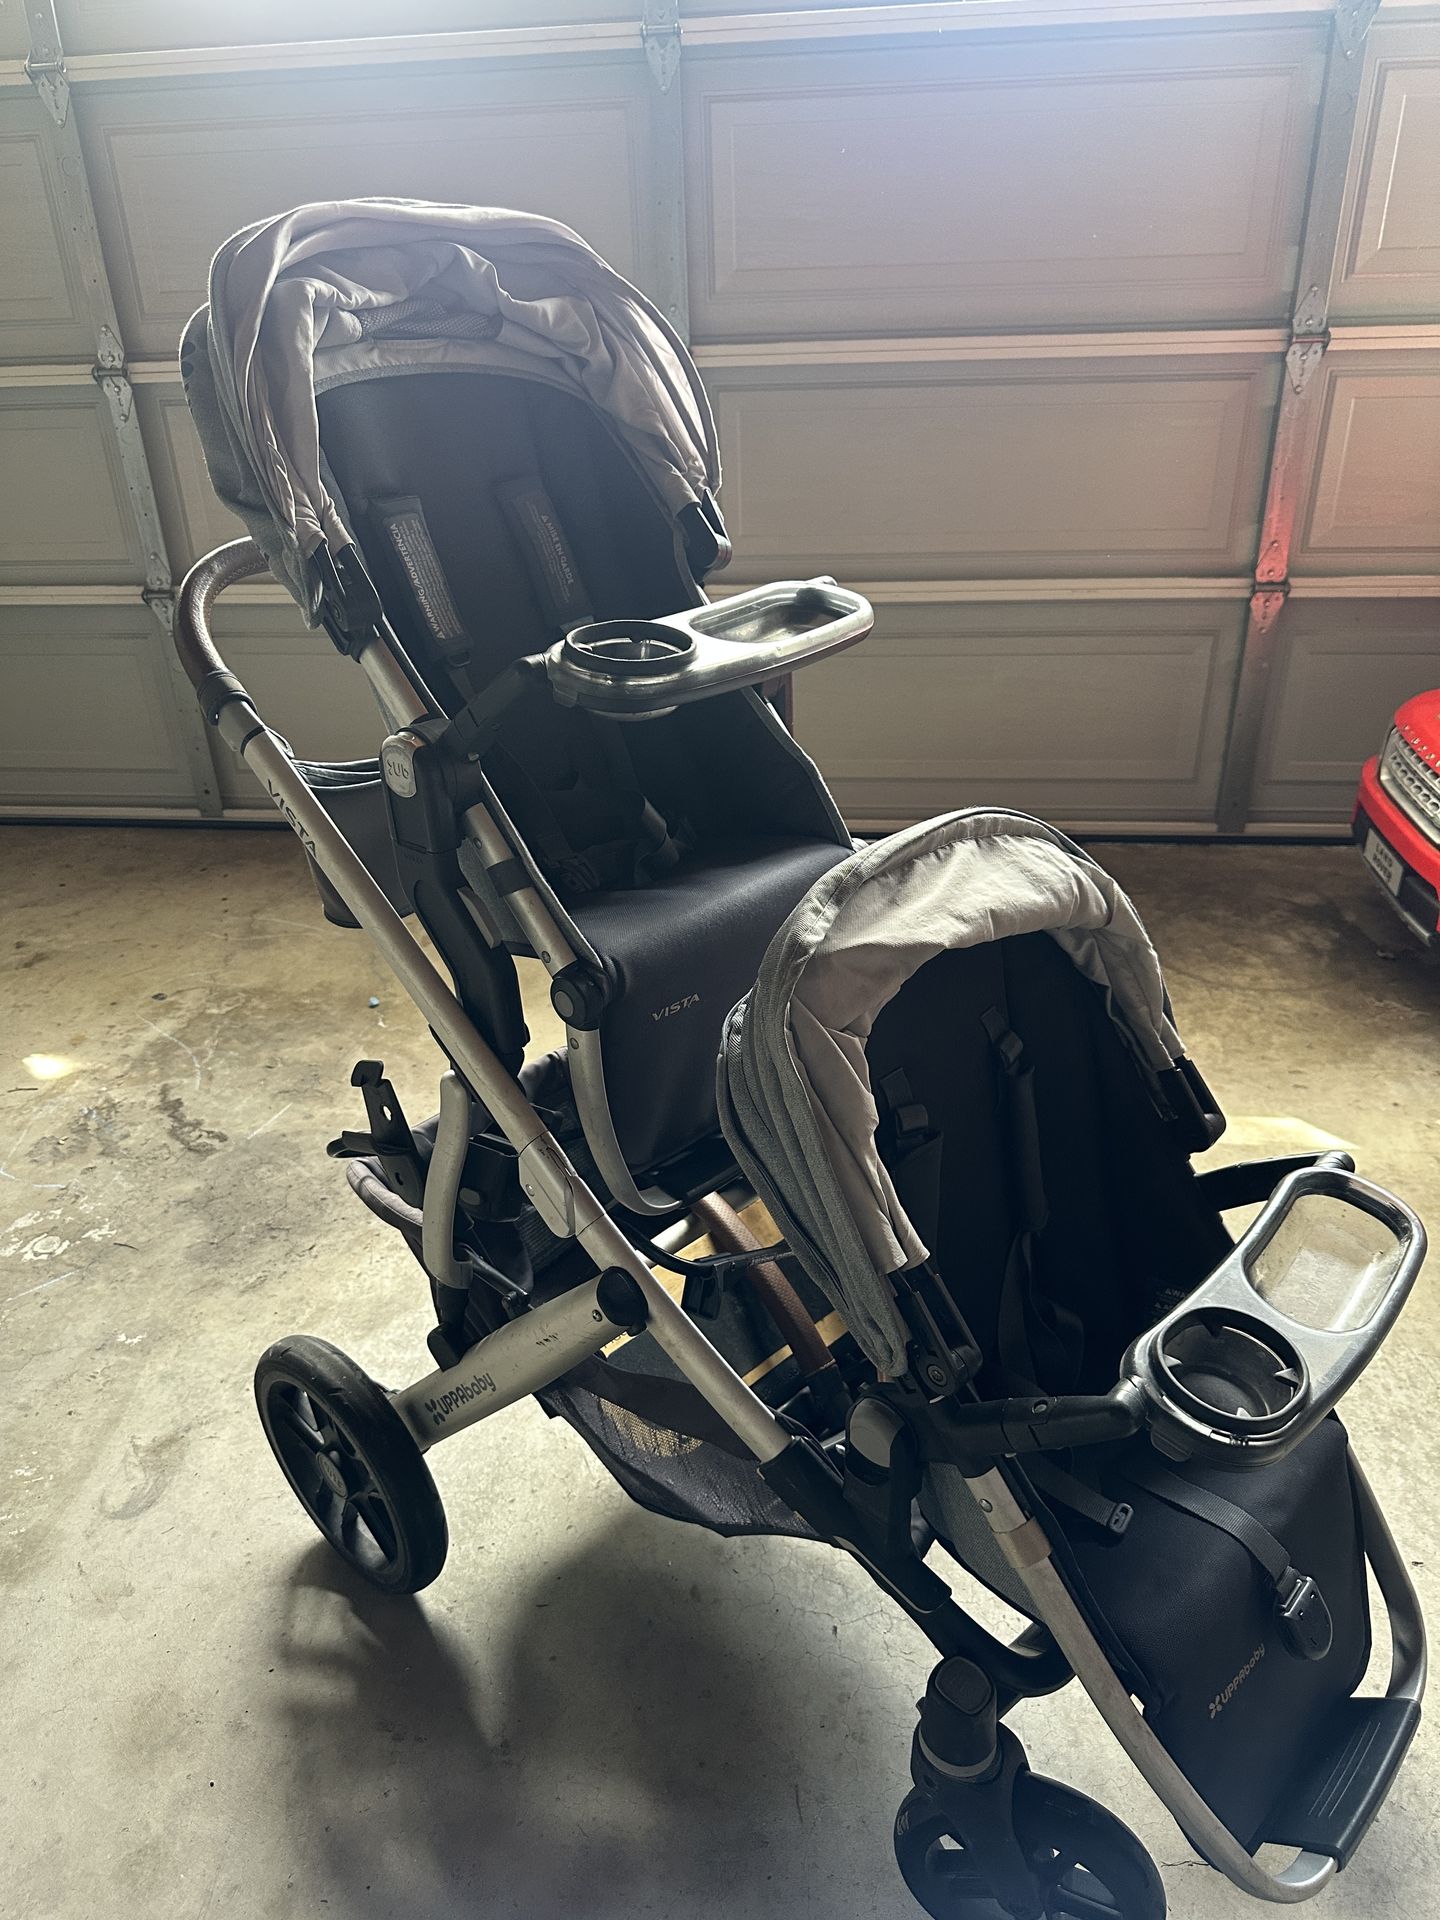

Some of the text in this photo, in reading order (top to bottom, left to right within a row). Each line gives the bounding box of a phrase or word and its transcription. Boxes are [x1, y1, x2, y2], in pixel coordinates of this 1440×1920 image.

[267, 779, 317, 859] VISTA
[651, 993, 700, 1021] VISTA
[436, 1372, 497, 1415] UPPAbaby
